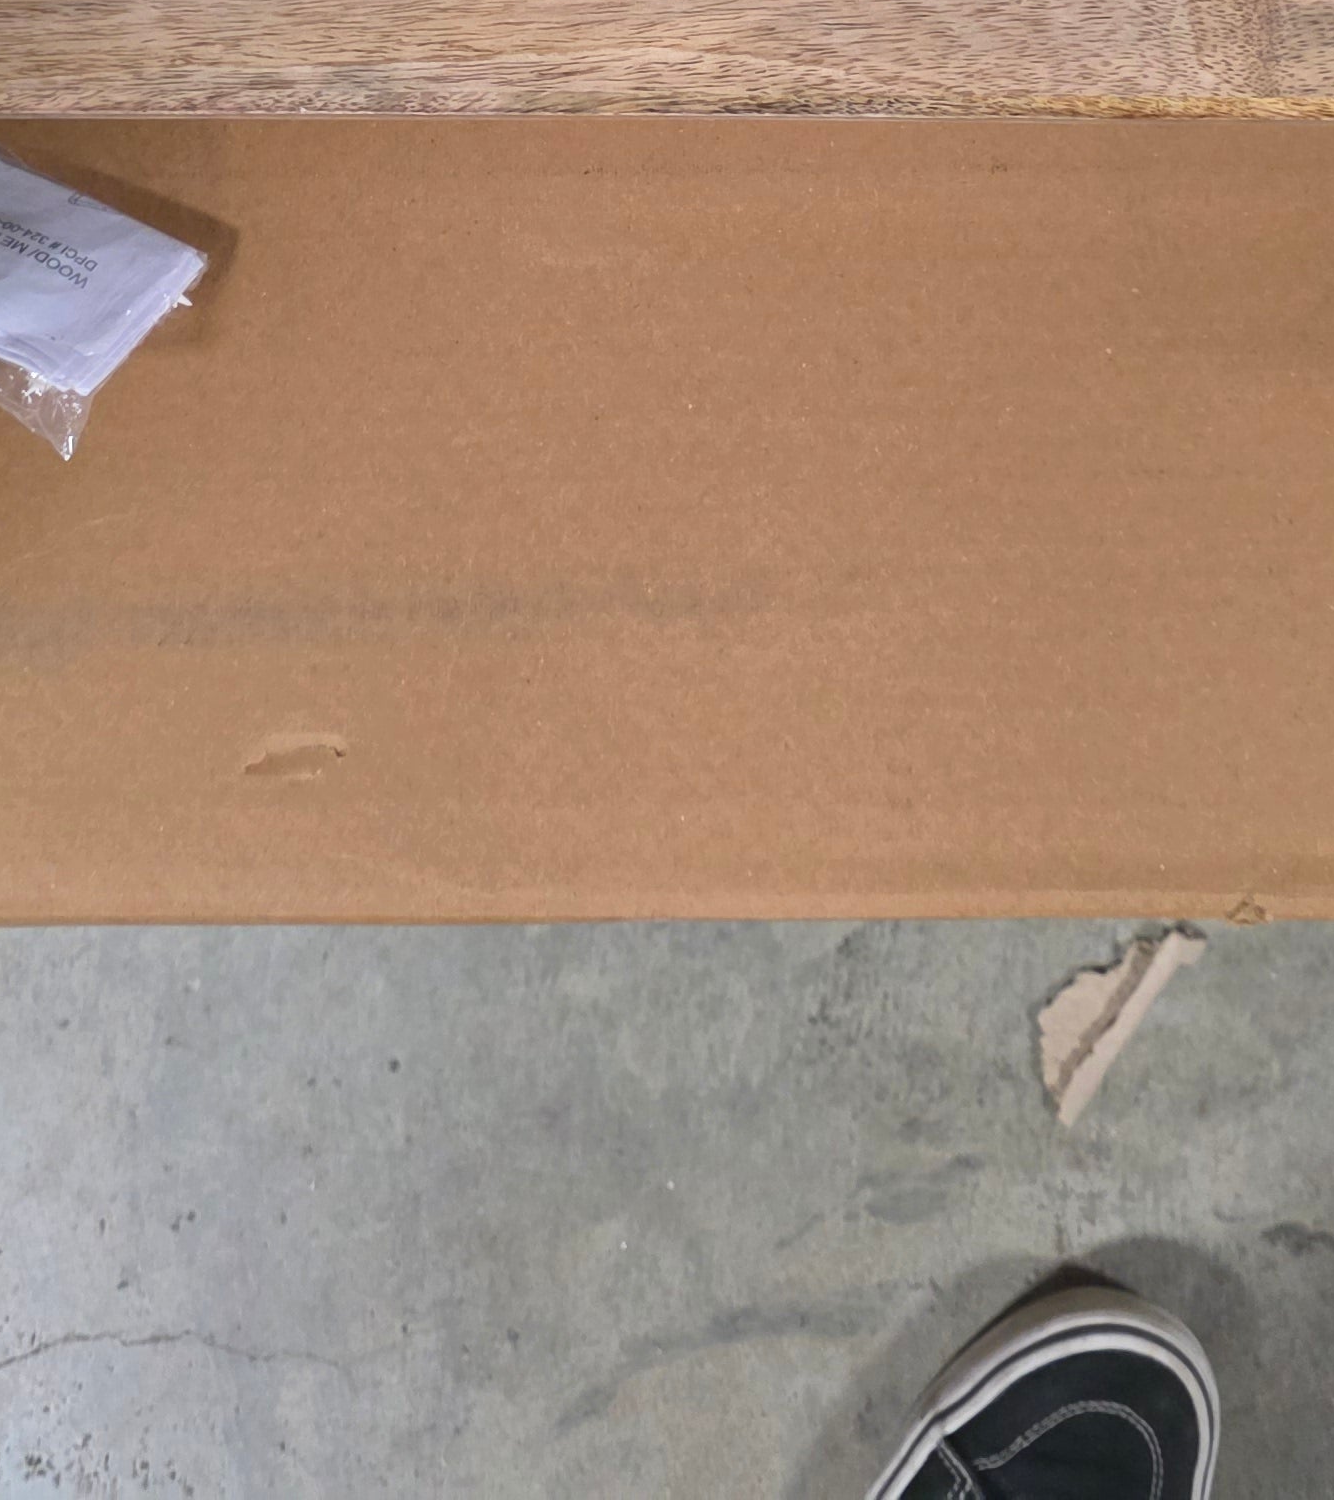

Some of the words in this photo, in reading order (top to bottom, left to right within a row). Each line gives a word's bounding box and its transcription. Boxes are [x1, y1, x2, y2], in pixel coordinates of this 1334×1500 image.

[49, 241, 62, 249] #
[28, 249, 89, 290] WOOD/
[60, 246, 98, 272] DPCI
